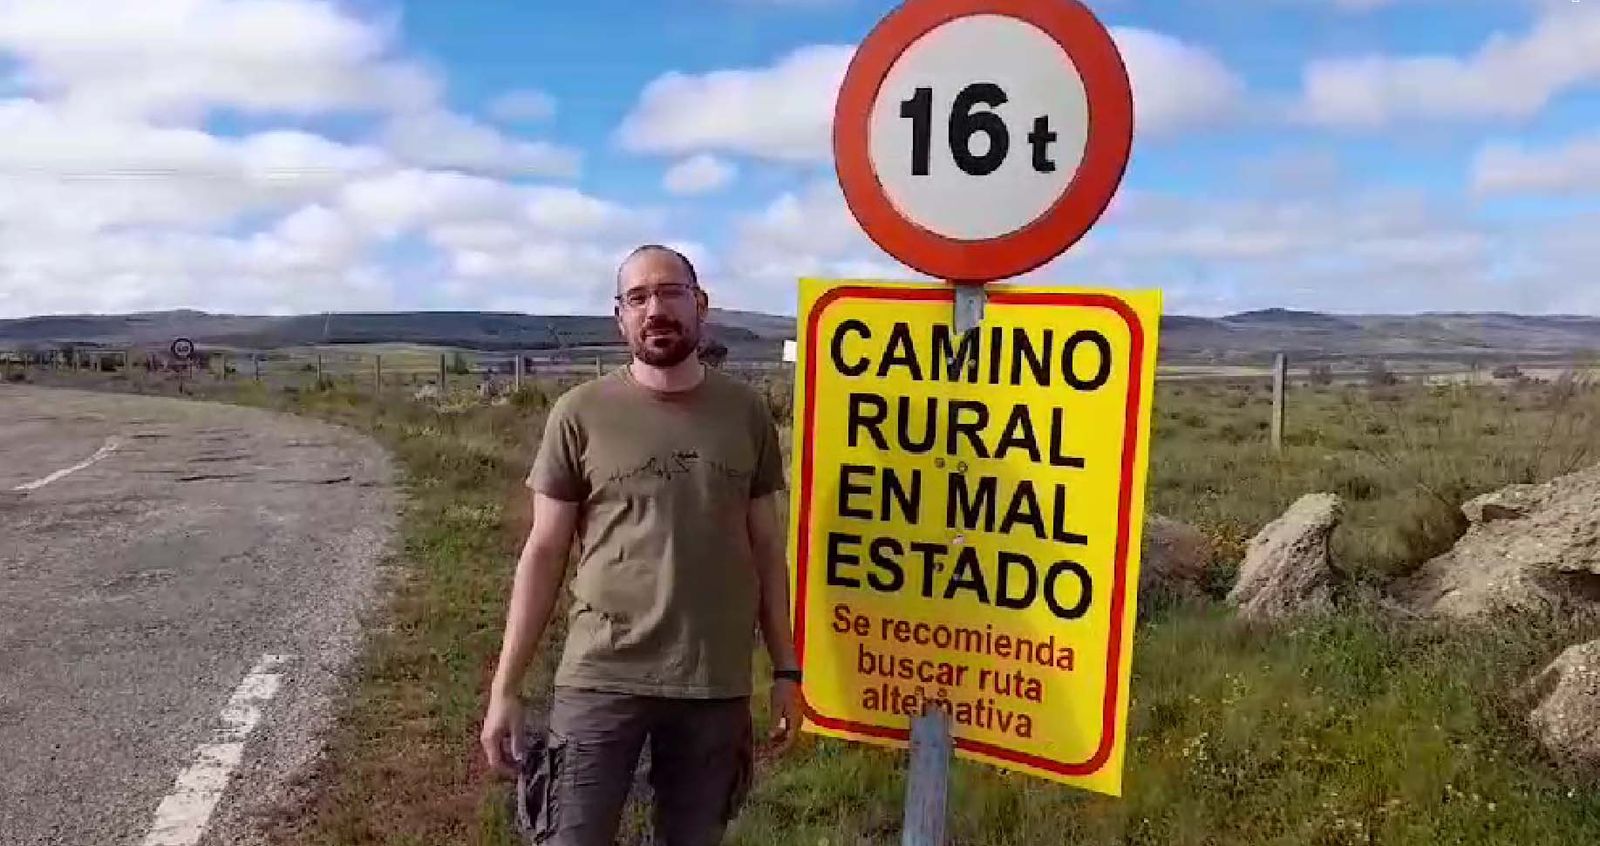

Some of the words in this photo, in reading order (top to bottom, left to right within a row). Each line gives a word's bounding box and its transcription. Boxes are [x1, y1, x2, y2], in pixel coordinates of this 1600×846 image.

[830, 319, 1111, 391] CAMINO
[847, 393, 1085, 469] RURAL
[838, 464, 921, 525] EN
[946, 473, 1088, 546] MAL
[826, 532, 1093, 619] ESTADO
[832, 603, 871, 637] Se
[881, 615, 1075, 672] recomienda
[857, 643, 969, 687] buscar
[979, 665, 1043, 704] ruta
